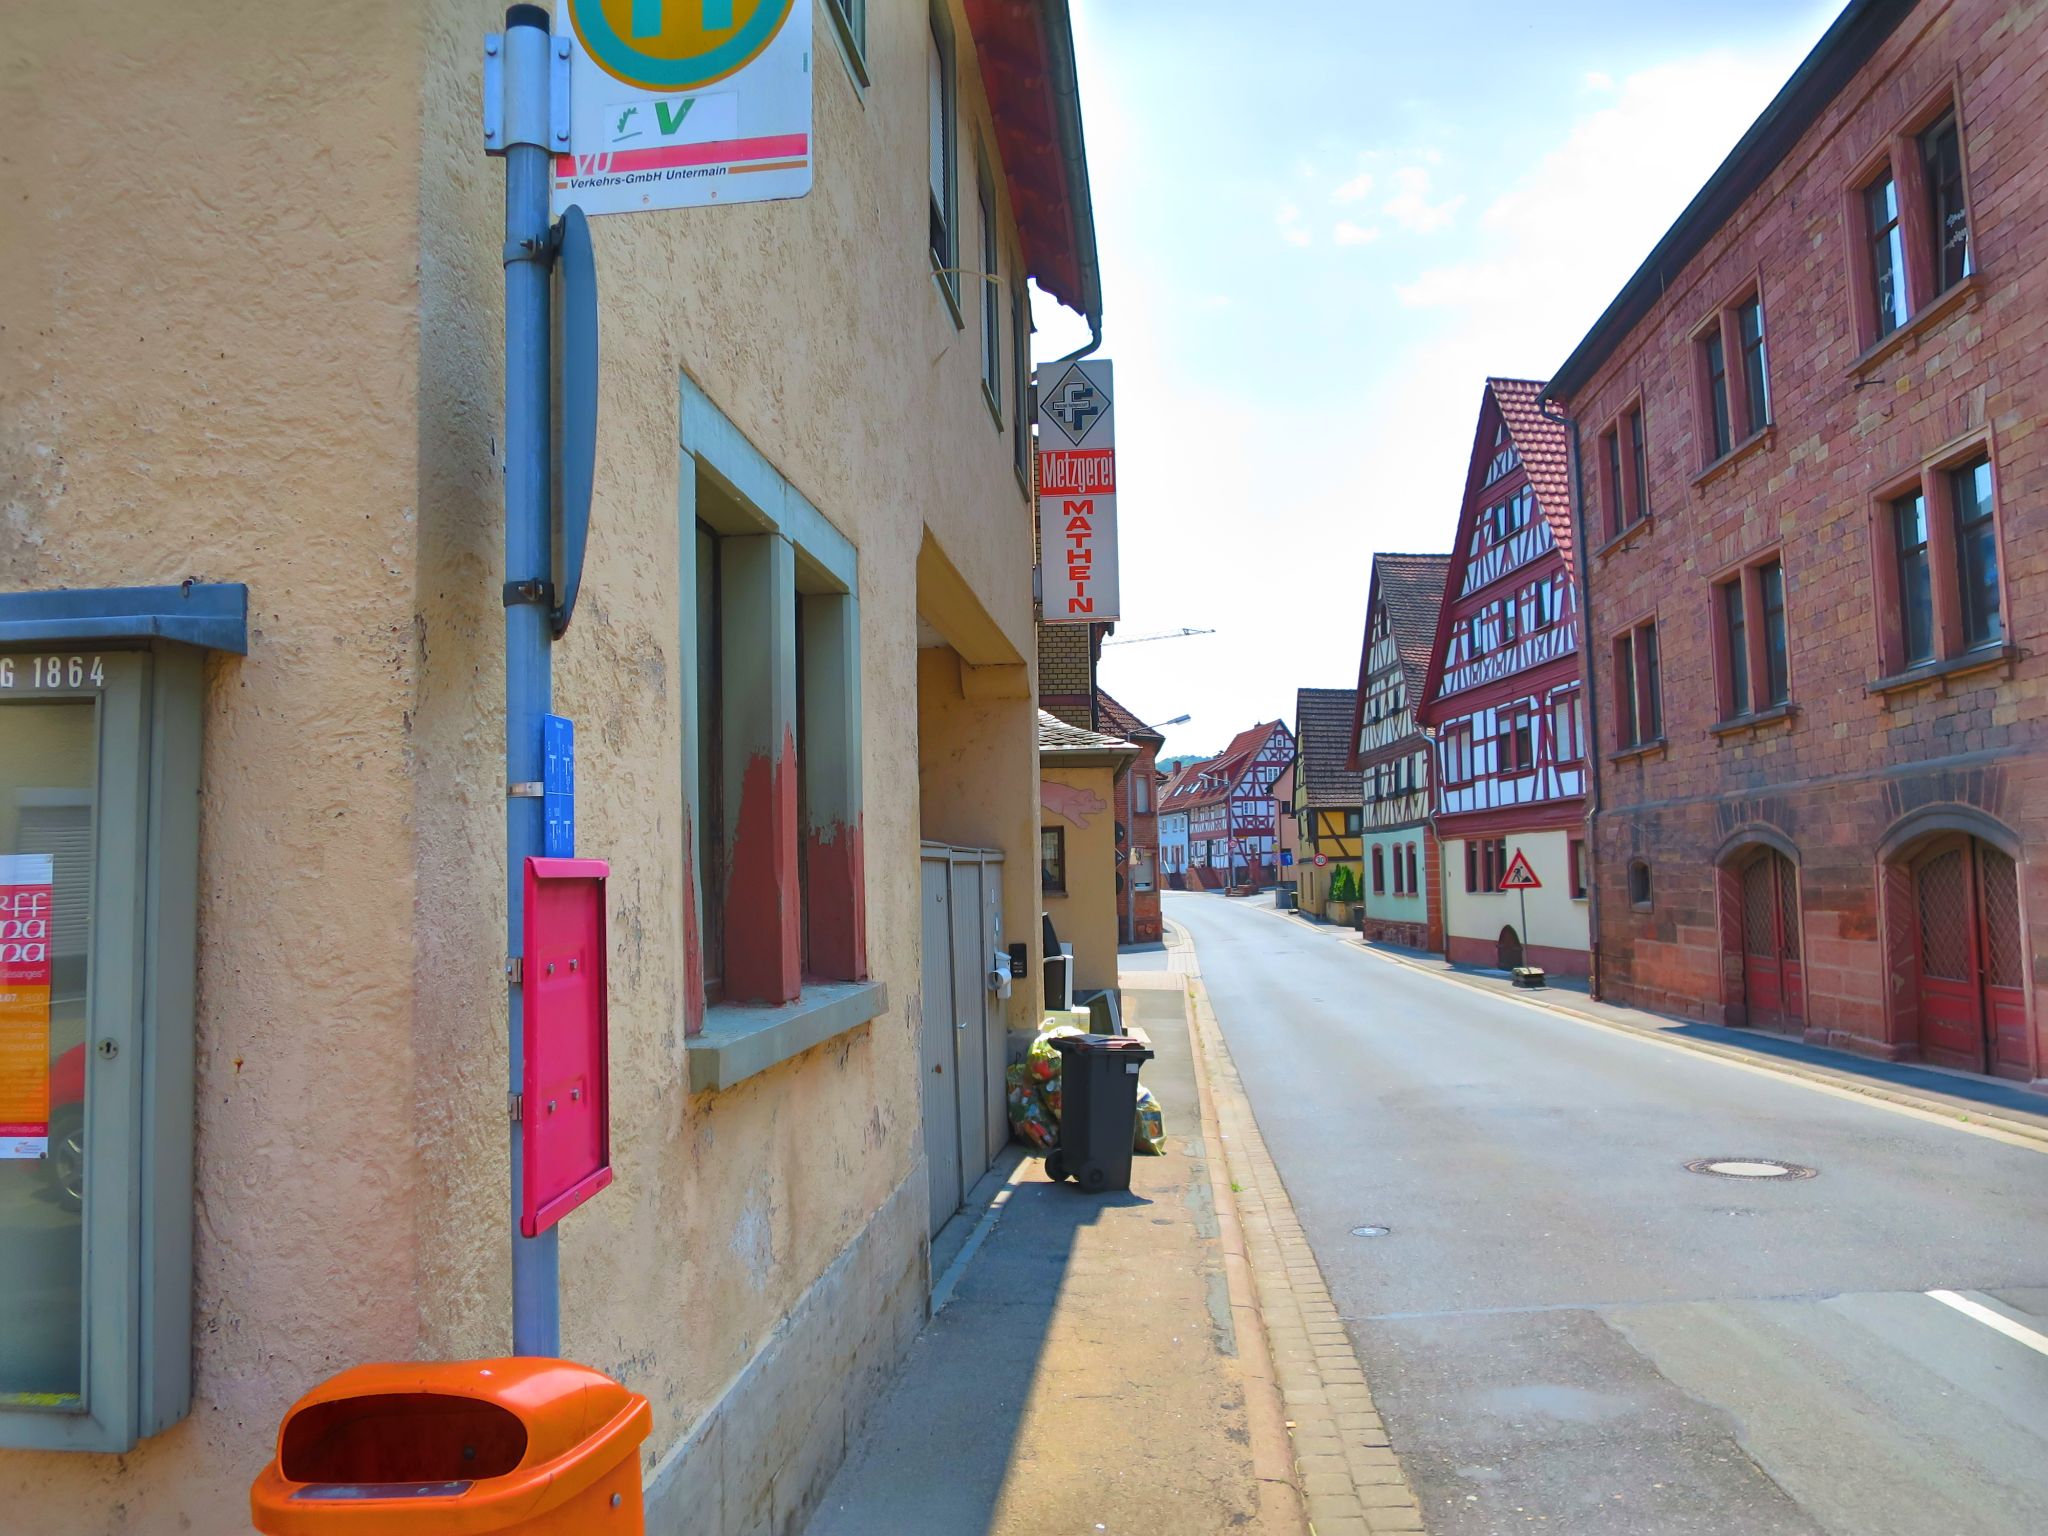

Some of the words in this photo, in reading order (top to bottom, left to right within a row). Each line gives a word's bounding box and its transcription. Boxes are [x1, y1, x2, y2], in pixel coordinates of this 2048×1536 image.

[570, 173, 663, 189] Verkehrs-GmbH
[666, 165, 727, 180] Untermain
[575, 152, 614, 176] VU
[1042, 451, 1113, 493] Metzgerei
[1063, 500, 1093, 613] MATHEIN
[33, 656, 104, 688] 1864
